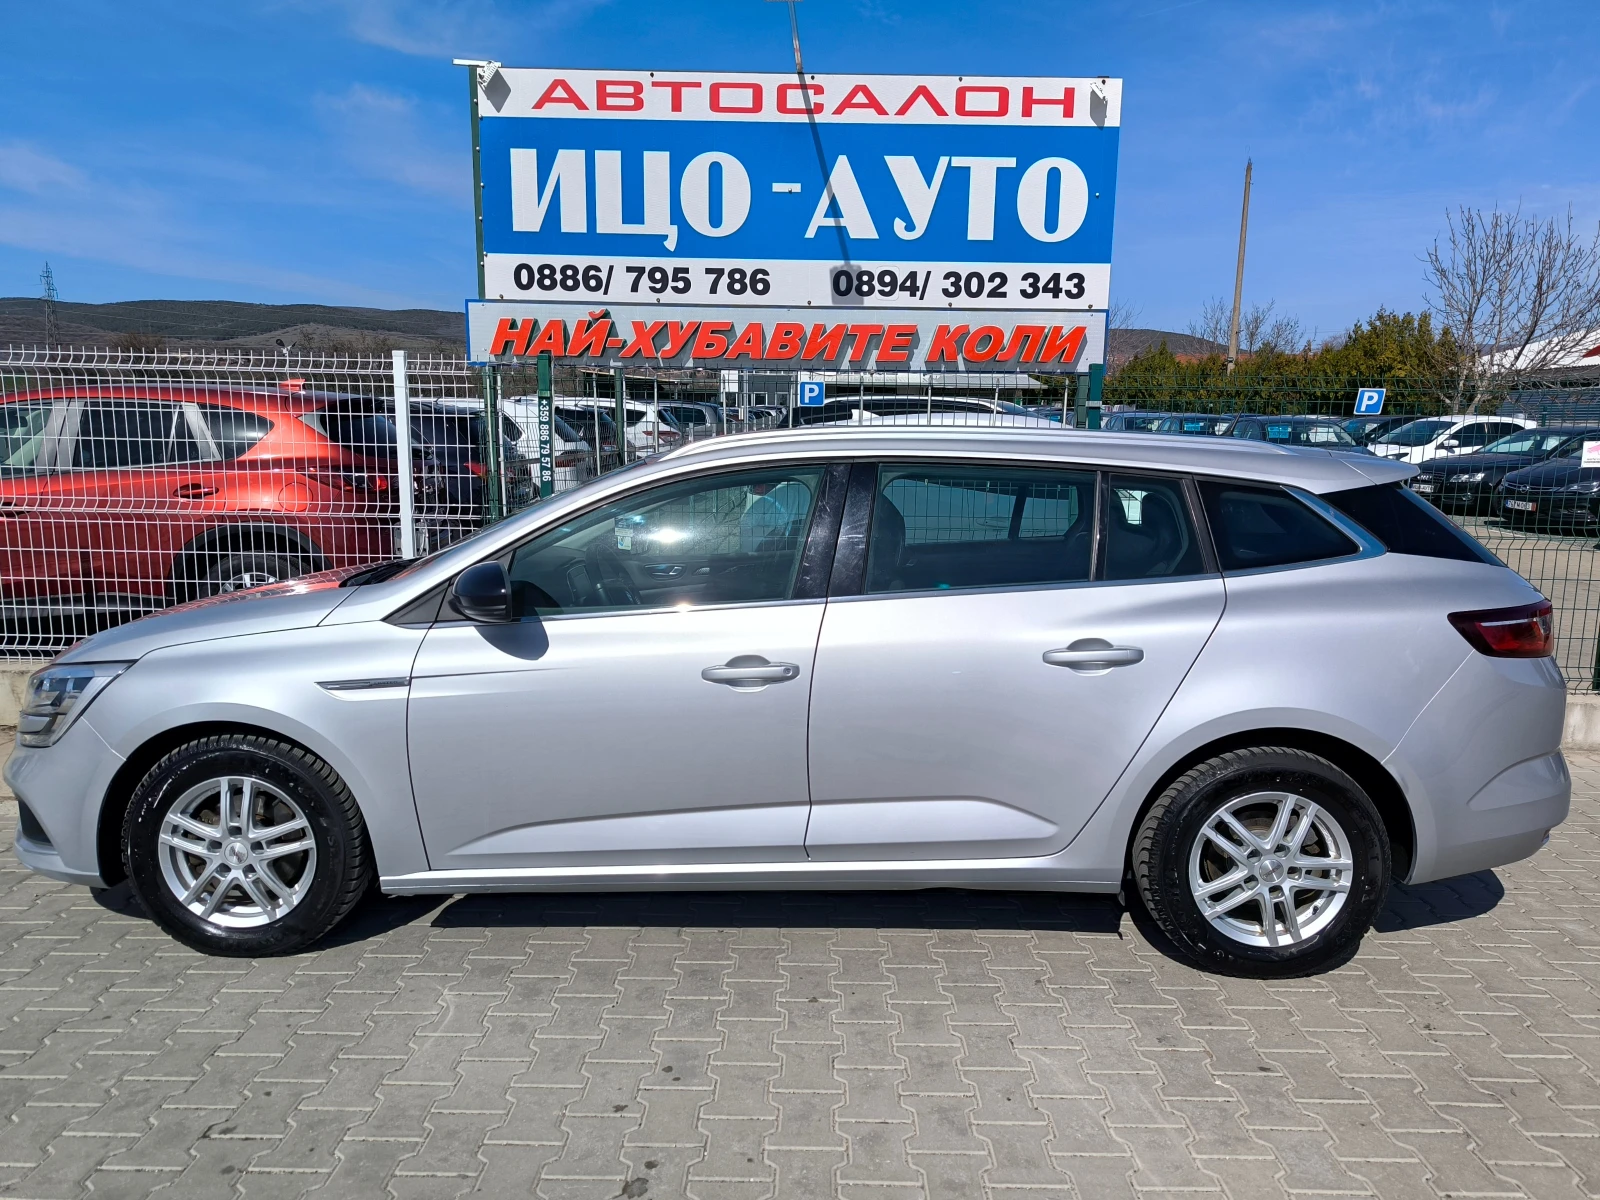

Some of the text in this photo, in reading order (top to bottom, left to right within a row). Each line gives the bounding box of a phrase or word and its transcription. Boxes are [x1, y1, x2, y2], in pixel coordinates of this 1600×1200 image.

[533, 78, 1076, 119] АВТОСАЛОН
[510, 148, 751, 252] ИЦО
[513, 263, 771, 297] 0886/ 795 786
[832, 269, 1085, 301] 0894/ 302 343
[489, 309, 1088, 364] НАЙ-ХУБАВИТЕ КОЛИ
[804, 383, 820, 404] P
[1360, 391, 1379, 412] P
[539, 398, 552, 482] +359 886 79 57 86
